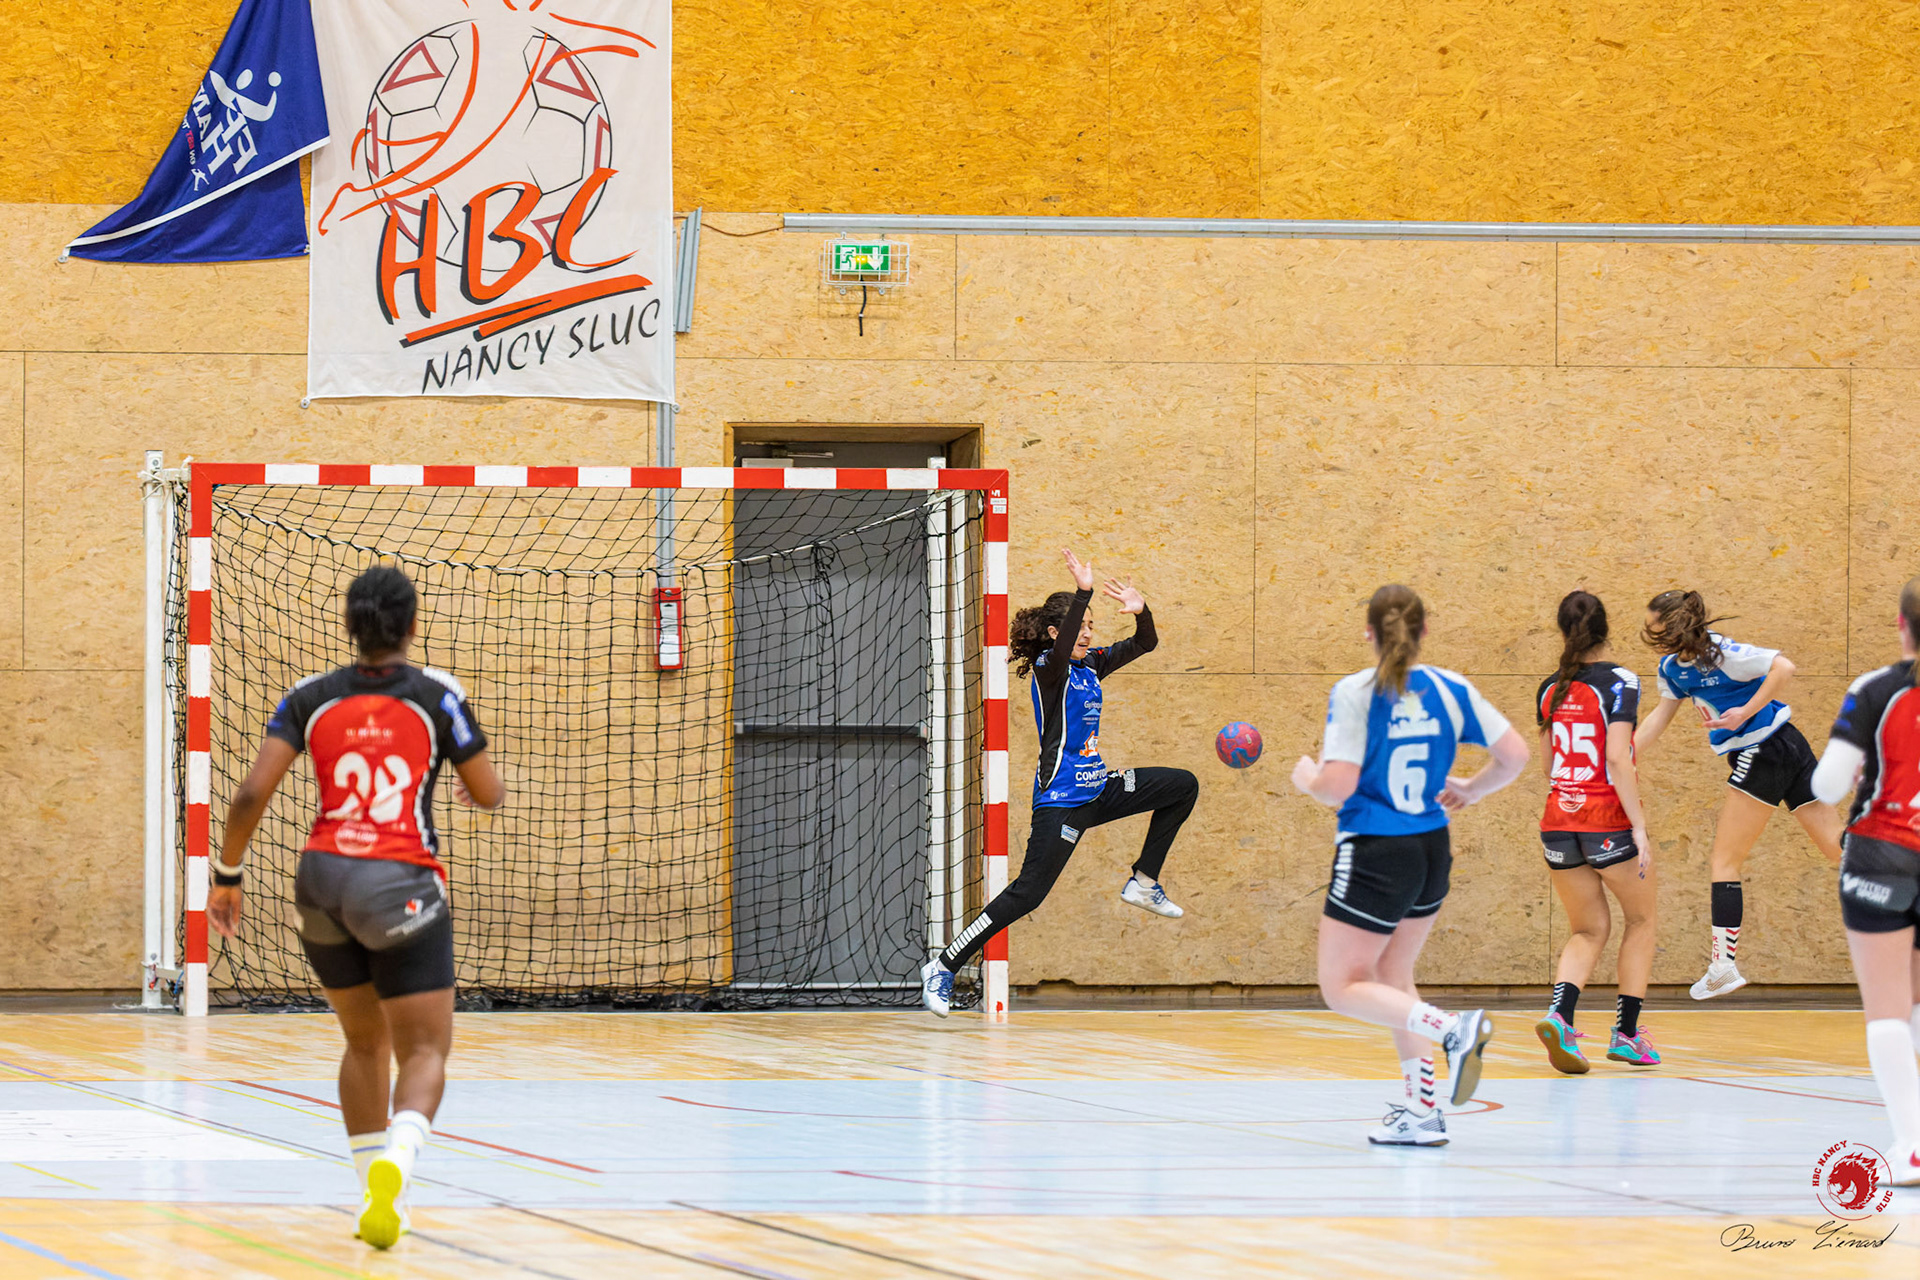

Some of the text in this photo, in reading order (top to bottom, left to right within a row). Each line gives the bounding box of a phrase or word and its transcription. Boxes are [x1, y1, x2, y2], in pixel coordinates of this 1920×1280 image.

[375, 167, 641, 325] HBC
[422, 298, 660, 394] NANCY SLUC
[325, 751, 412, 824] 28
[1387, 742, 1429, 815] 6
[1550, 721, 1599, 781] 25
